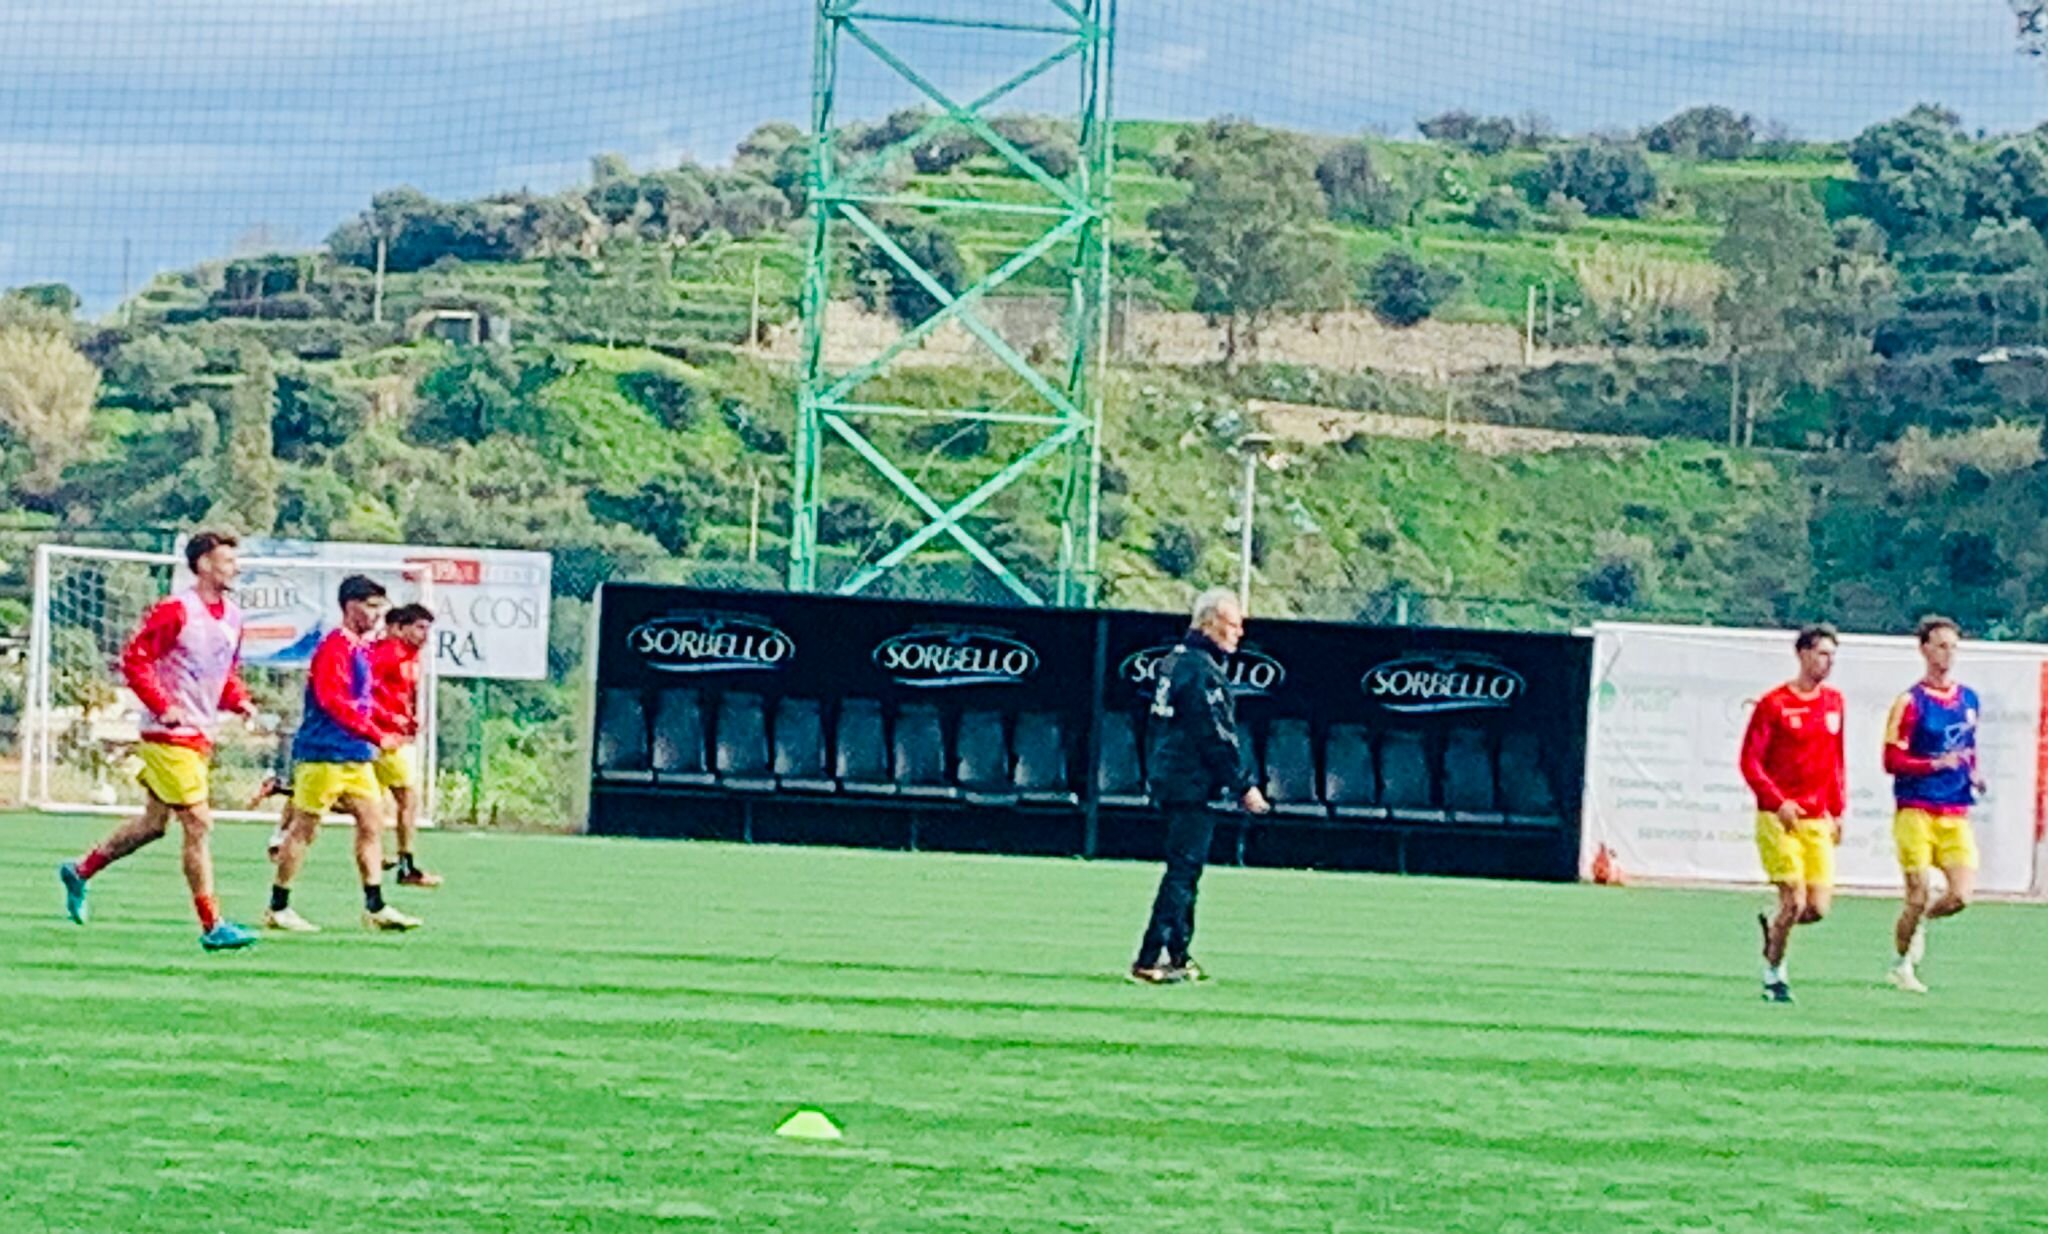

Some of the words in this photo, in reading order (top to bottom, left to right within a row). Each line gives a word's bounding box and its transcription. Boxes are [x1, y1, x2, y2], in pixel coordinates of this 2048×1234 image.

[639, 627, 785, 663] SORBELLO
[884, 641, 1028, 675] SORBELLO
[1372, 669, 1516, 700] SORBELLO
